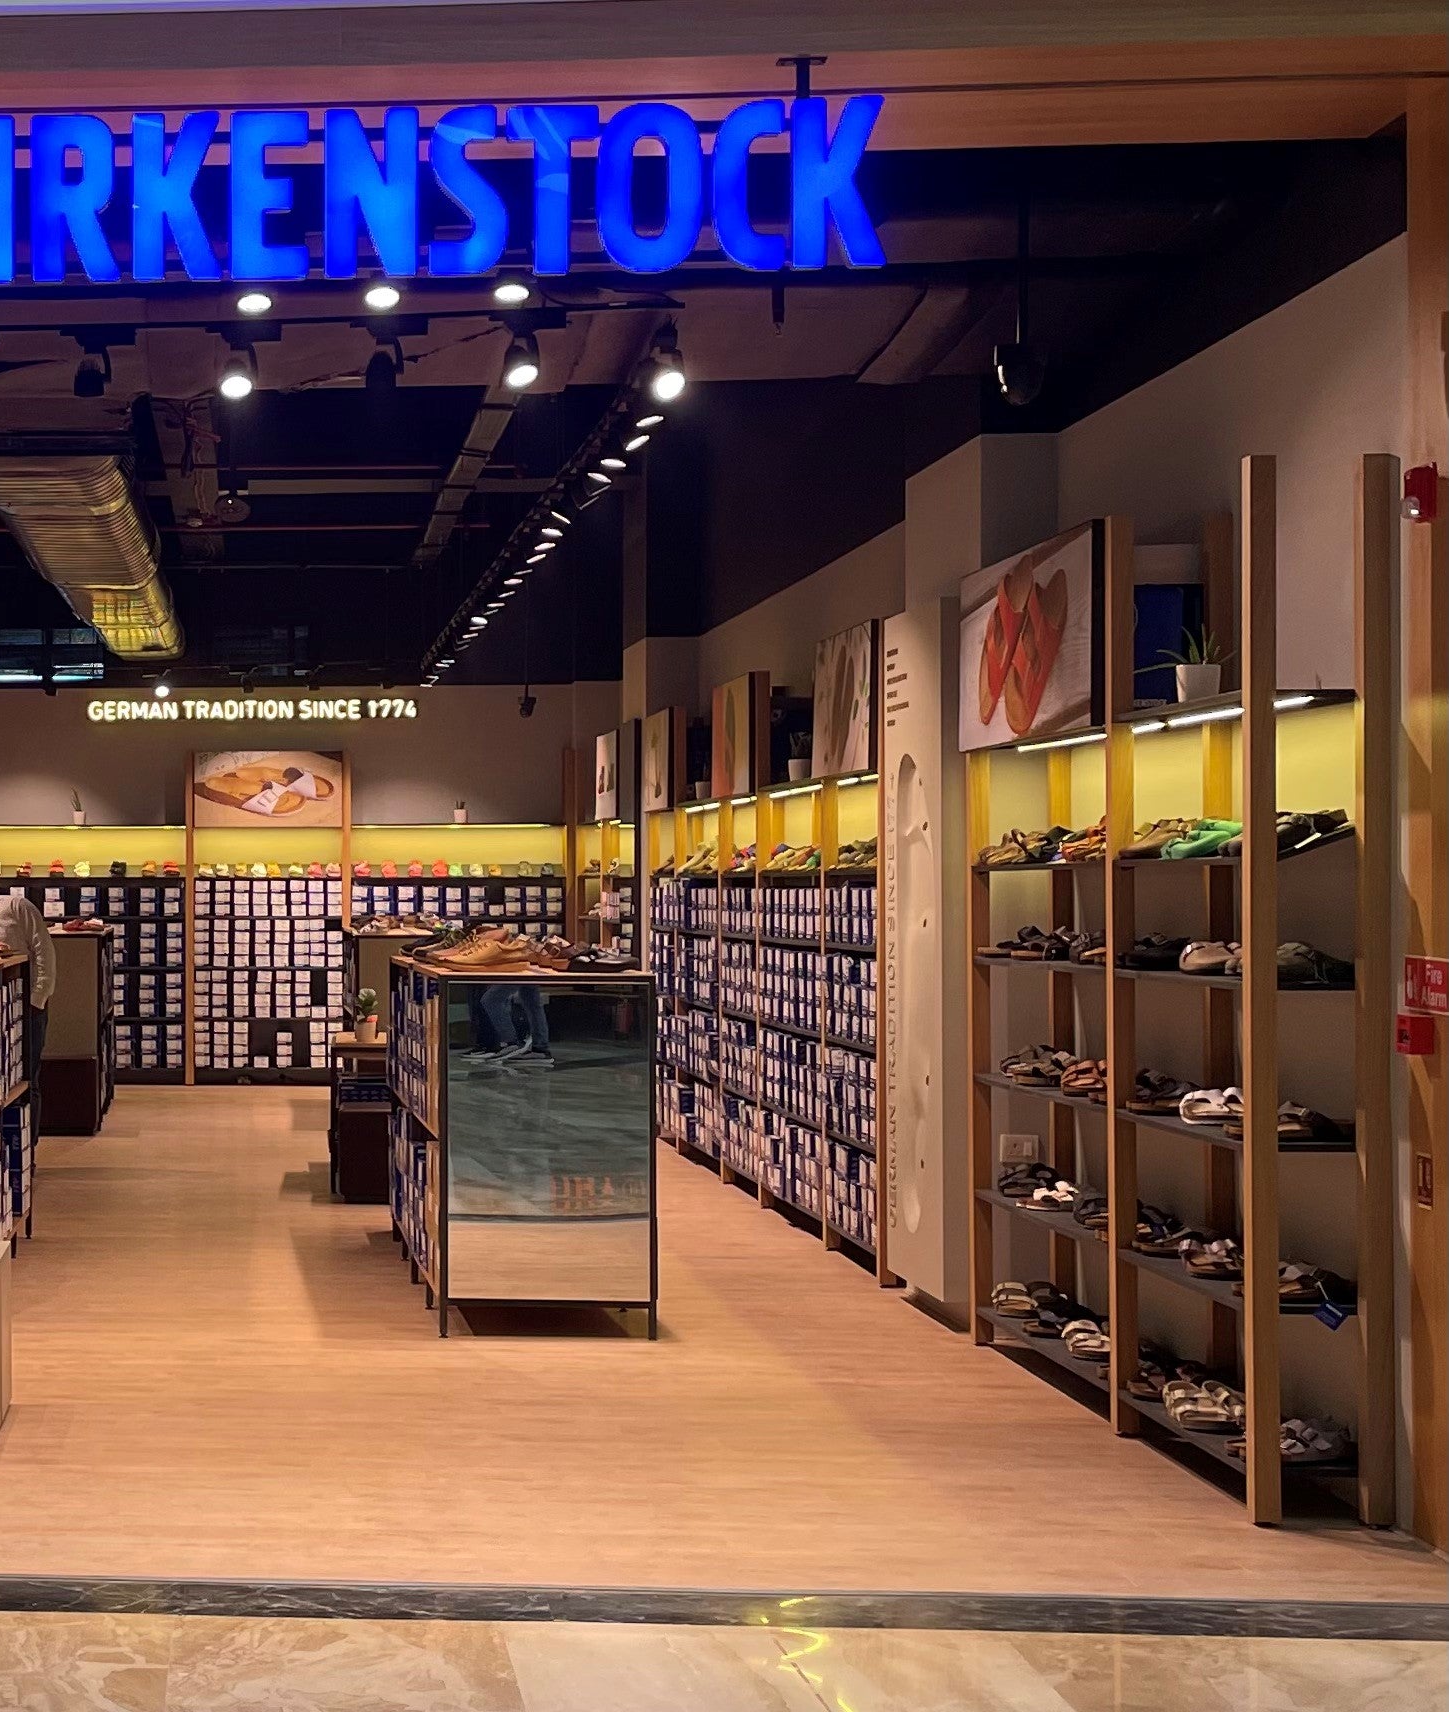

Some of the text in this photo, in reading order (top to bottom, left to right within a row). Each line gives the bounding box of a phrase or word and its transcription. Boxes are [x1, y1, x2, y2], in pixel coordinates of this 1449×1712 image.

[88, 699, 417, 721] GERMAN TRADITION SINCE 1774
[1425, 964, 1443, 985] Fire
[1422, 985, 1447, 1007] Alarm
